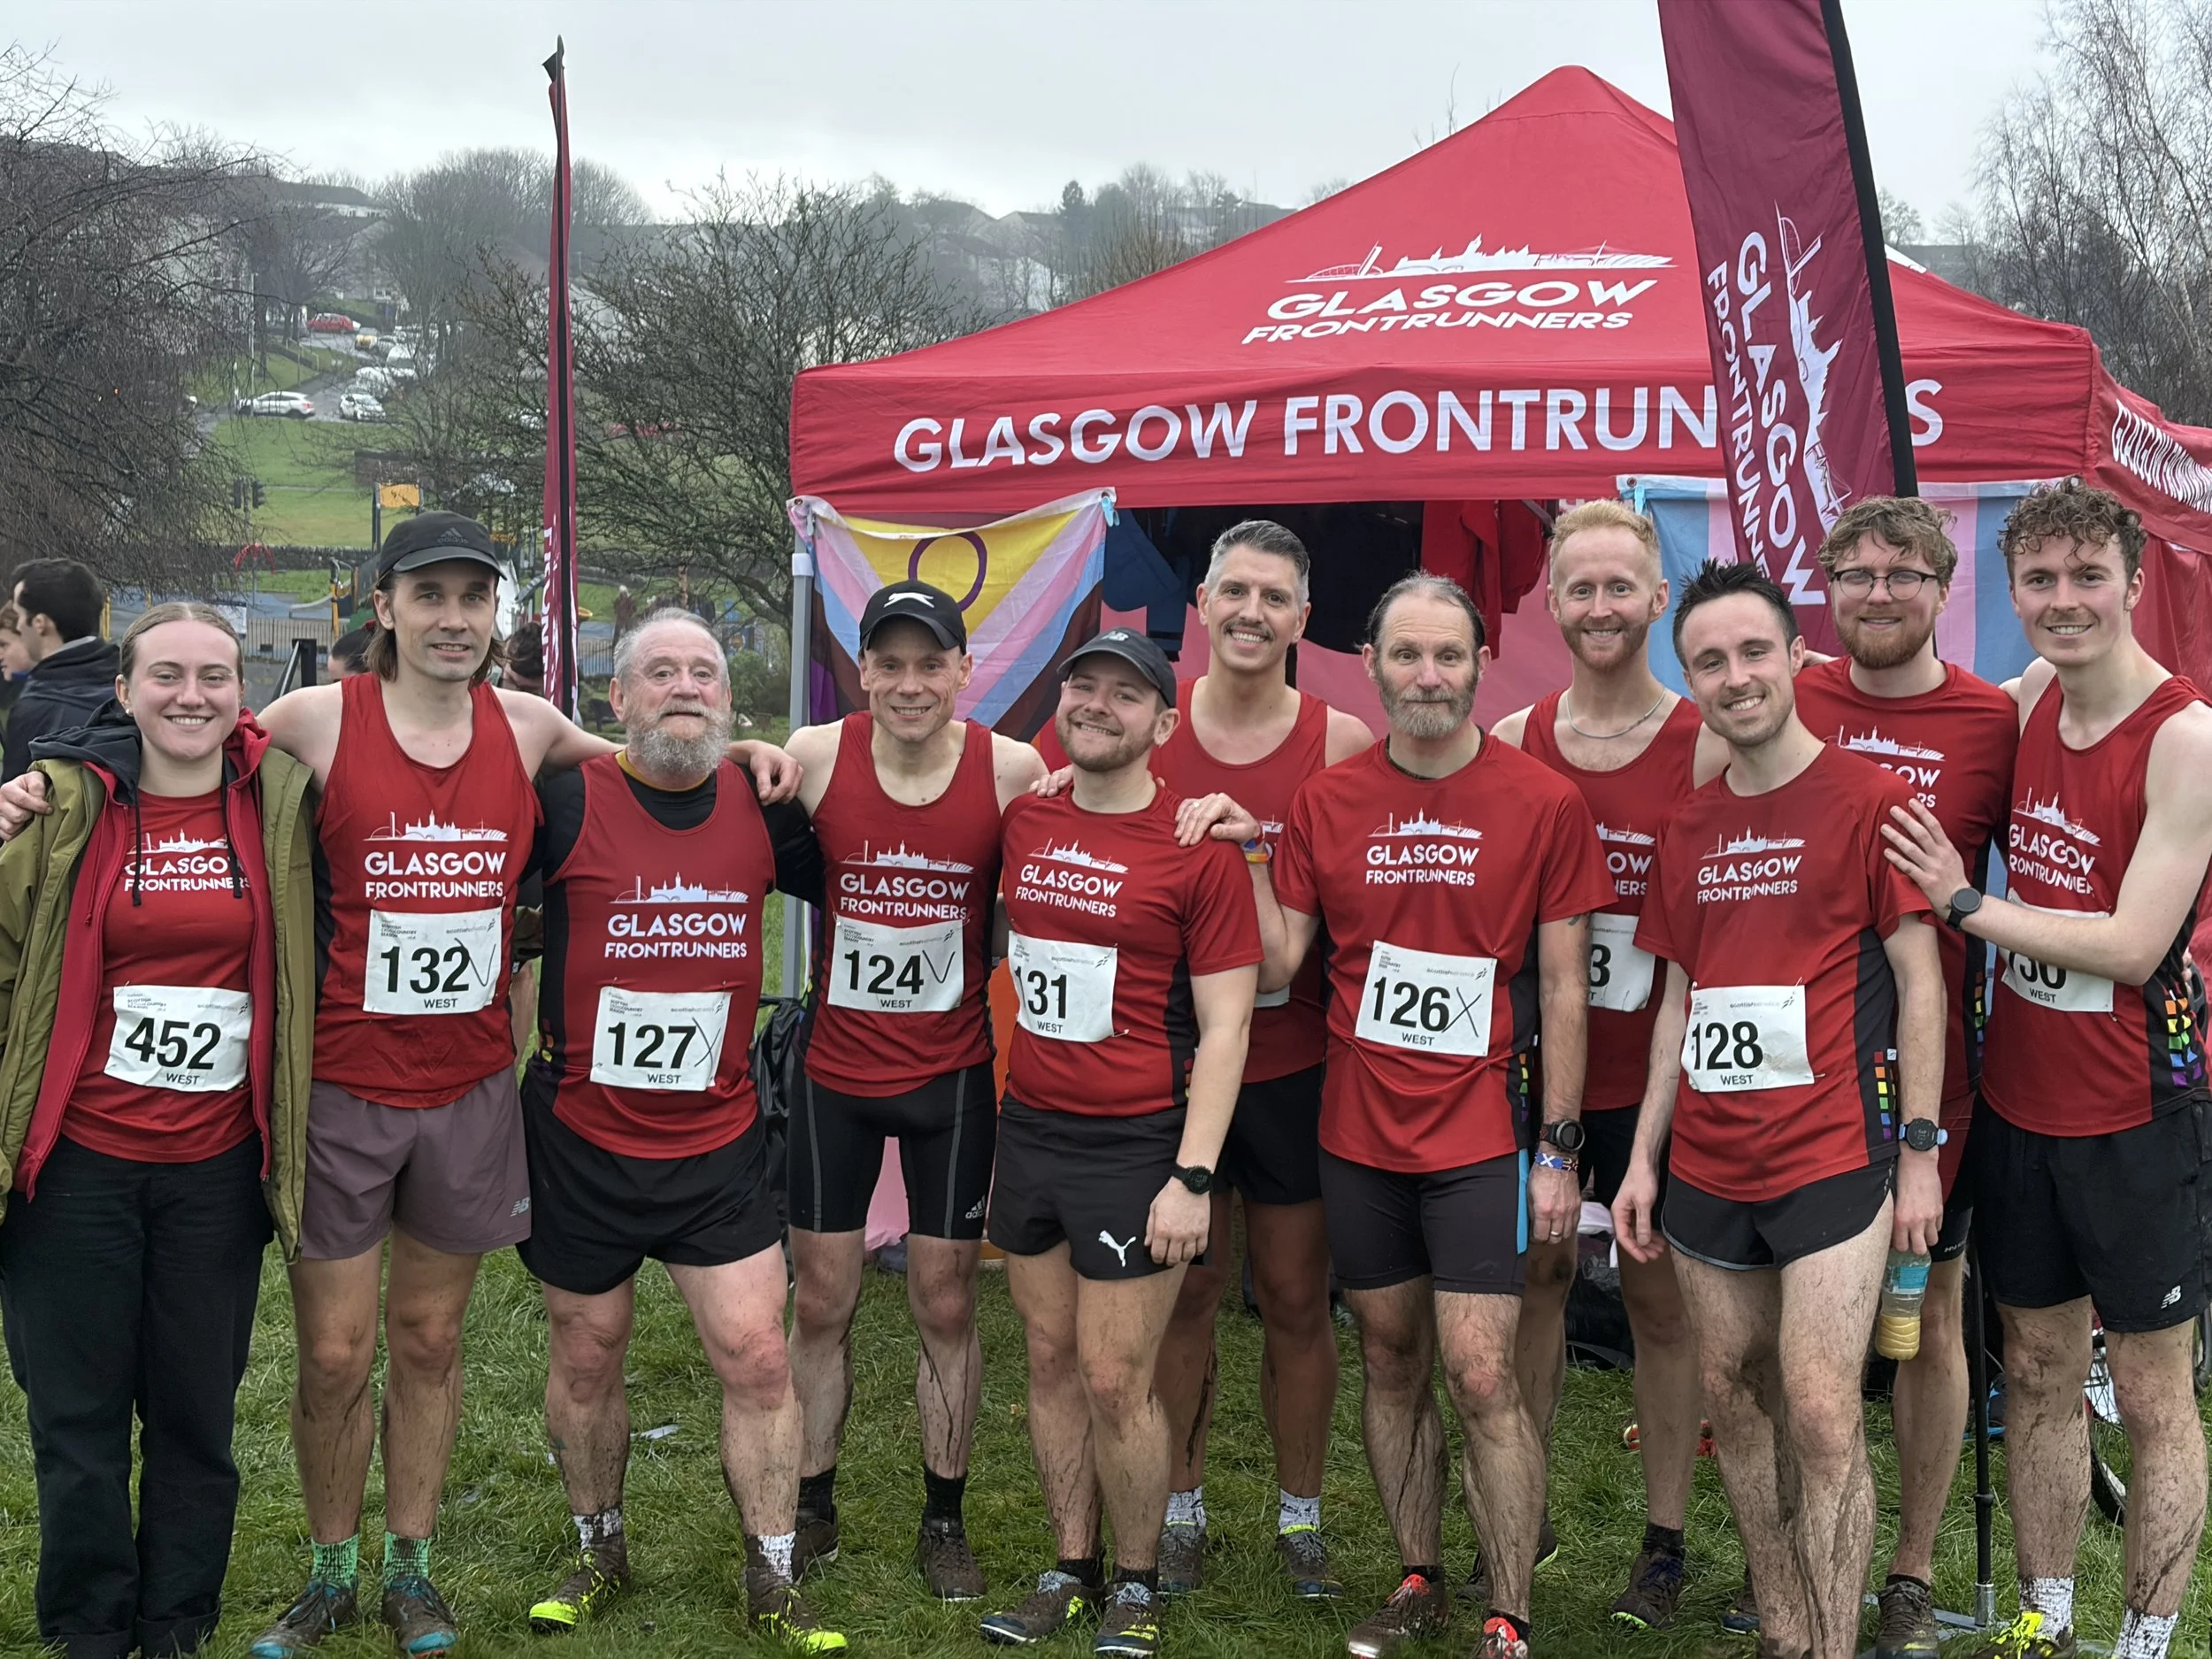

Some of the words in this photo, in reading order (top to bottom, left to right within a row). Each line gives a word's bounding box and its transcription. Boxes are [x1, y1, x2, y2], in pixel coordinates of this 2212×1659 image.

[1267, 280, 1658, 319] GLASGOW
[1241, 311, 1632, 345] FRONTRUNNERS
[893, 399, 1257, 472] GLASGOW
[1284, 379, 1943, 456] FRONTRUNS
[1737, 231, 1826, 605] GLASGOW
[124, 856, 244, 876] GLASGO
[365, 851, 506, 876] GLASGOW
[1366, 843, 1479, 867] GLASGOW
[1020, 864, 1124, 898] GLASGOW
[1365, 868, 1476, 886] FRONTRUNNERS
[1697, 855, 1802, 886] GLASGOW
[365, 880, 503, 898] FRONTRUNNERS
[840, 872, 970, 902] GLASGOW
[1697, 879, 1798, 905] FRONTRNNERS
[840, 896, 967, 919] FRONTRUNNERS
[1015, 886, 1117, 918] FRONTRUNNERS
[607, 912, 747, 937] GLASGOW
[604, 941, 747, 959] FRONTRUNNERS
[380, 946, 470, 994] 132
[844, 949, 924, 995] 124
[424, 998, 458, 1009] WEST
[880, 999, 913, 1009] WEST
[1373, 976, 1451, 1033] 126
[2030, 987, 2056, 1003] WEST
[1037, 1020, 1063, 1033] WEST
[124, 1018, 221, 1071] 452
[607, 1021, 697, 1070] 127
[1402, 1032, 1435, 1047] WEST
[1692, 1020, 1764, 1071] 128
[166, 1073, 200, 1086] WEST
[648, 1074, 681, 1084] WEST
[1720, 1074, 1755, 1086] WEST
